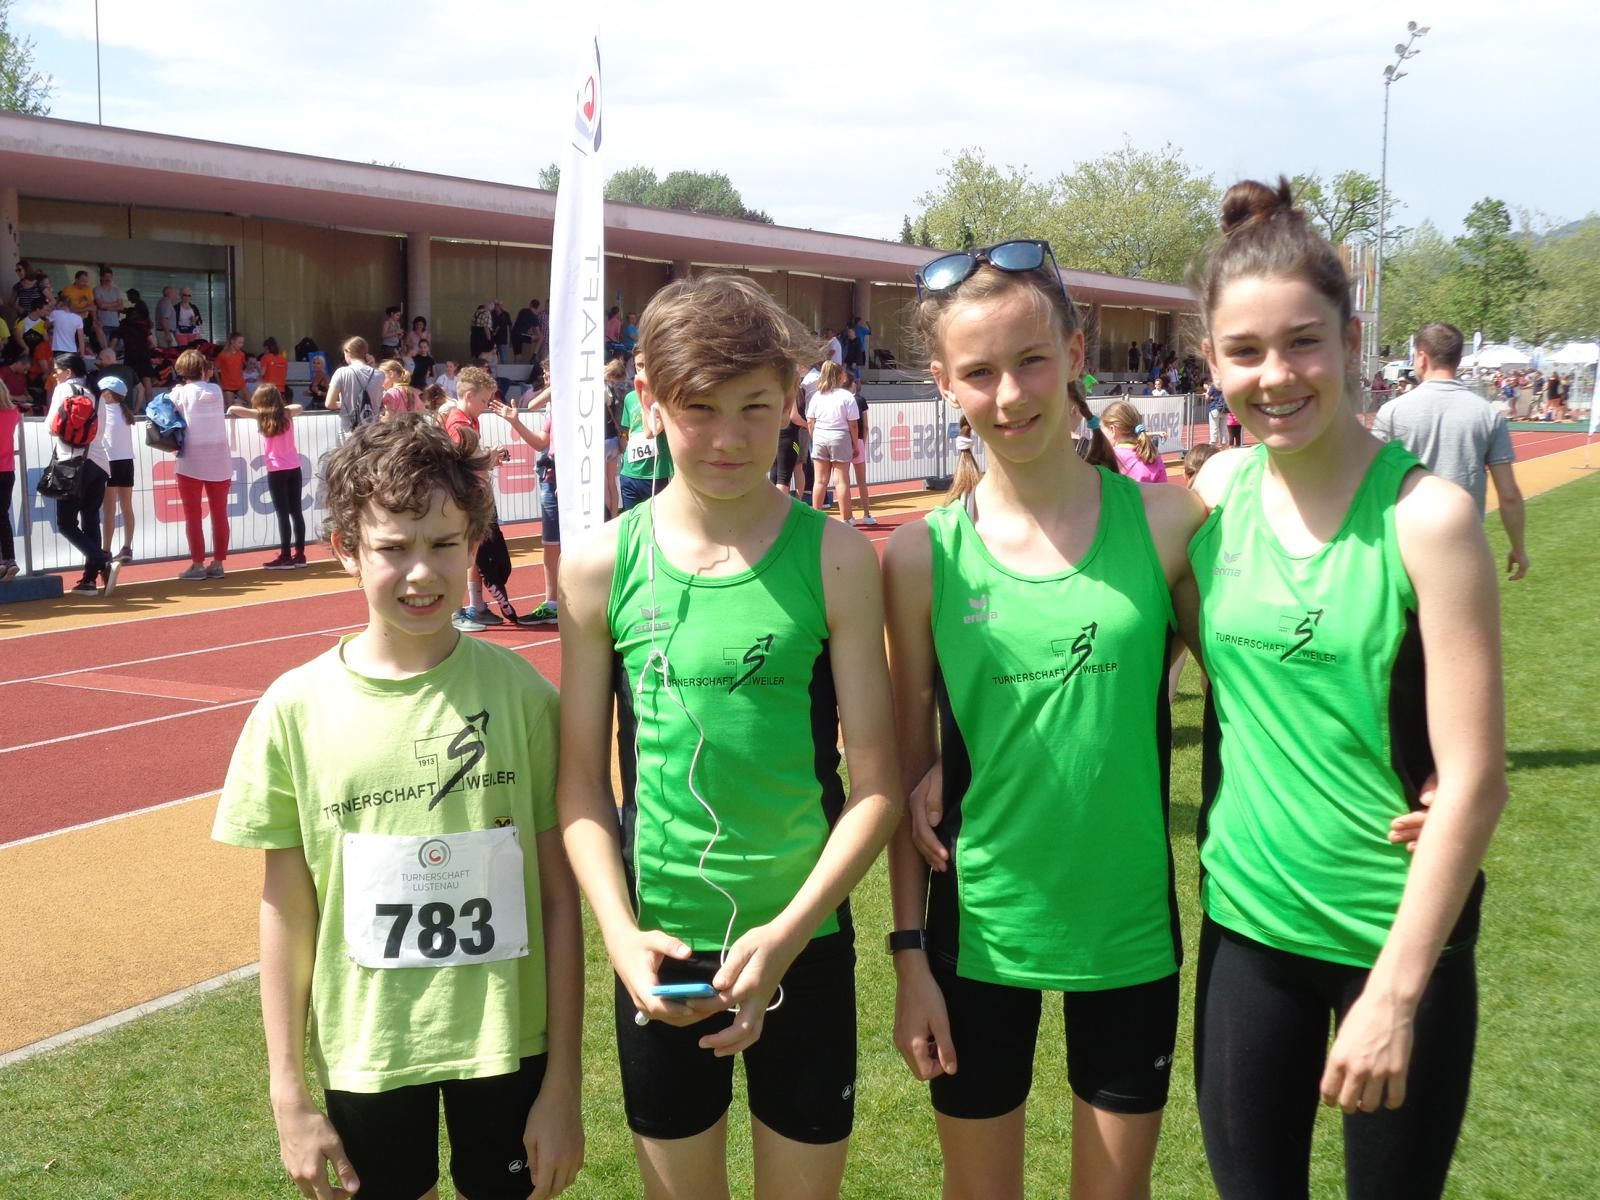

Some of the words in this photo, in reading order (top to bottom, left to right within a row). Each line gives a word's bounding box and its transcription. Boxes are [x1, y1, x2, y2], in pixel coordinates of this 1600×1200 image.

[632, 445, 652, 459] 764
[1215, 632, 1286, 654] TURNERSCHAFT
[1302, 649, 1337, 663] WEILER
[992, 668, 1066, 685] TURNERSCHAFT
[1082, 662, 1118, 675] WEILER
[752, 676, 784, 686] WEILER
[418, 758, 435, 768] 1913
[323, 781, 437, 820] TRNERSCHAFT
[466, 771, 516, 790] WEILER
[401, 869, 471, 882] TURNERSCHAFT
[412, 881, 460, 892] LUSTENAU
[375, 897, 495, 959] 783
